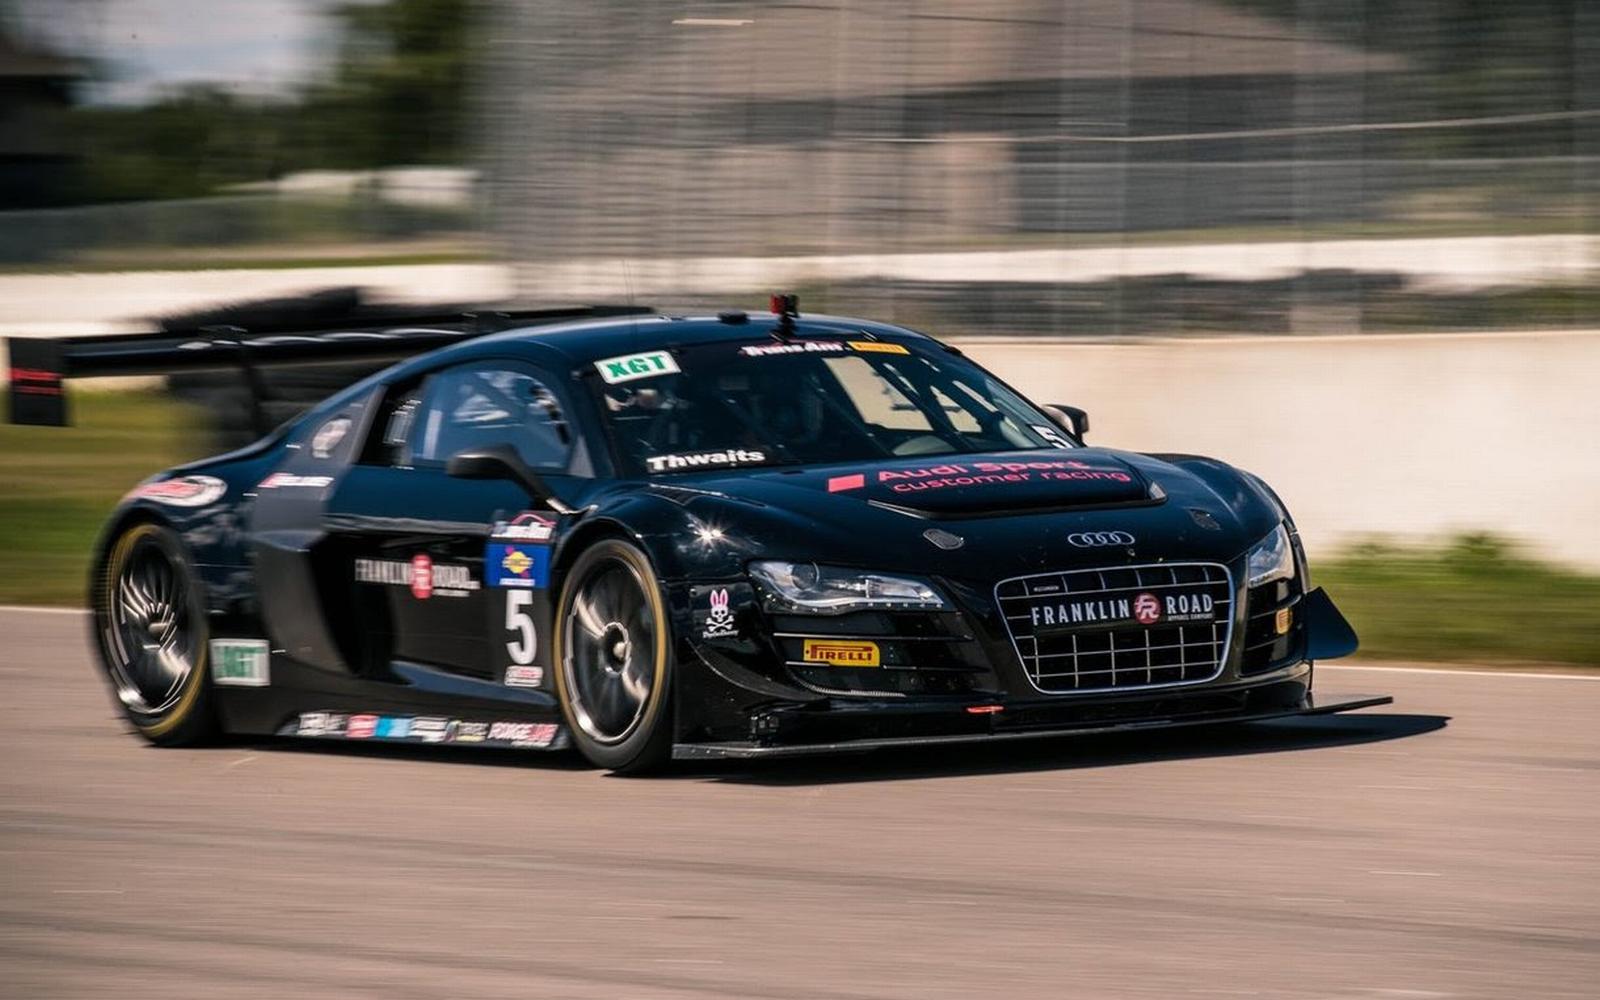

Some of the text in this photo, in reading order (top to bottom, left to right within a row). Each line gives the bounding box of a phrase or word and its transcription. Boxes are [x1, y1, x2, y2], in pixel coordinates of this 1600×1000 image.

[606, 355, 667, 378] XGT
[1031, 425, 1073, 449] 5
[646, 450, 766, 471] Thwaits
[878, 461, 1091, 482] Audi Sport
[892, 469, 1132, 493] customer racing
[1031, 599, 1130, 626] FRANKLIN
[1166, 594, 1213, 614] ROAD
[505, 589, 537, 665] 5
[810, 644, 873, 662] PIRELLI
